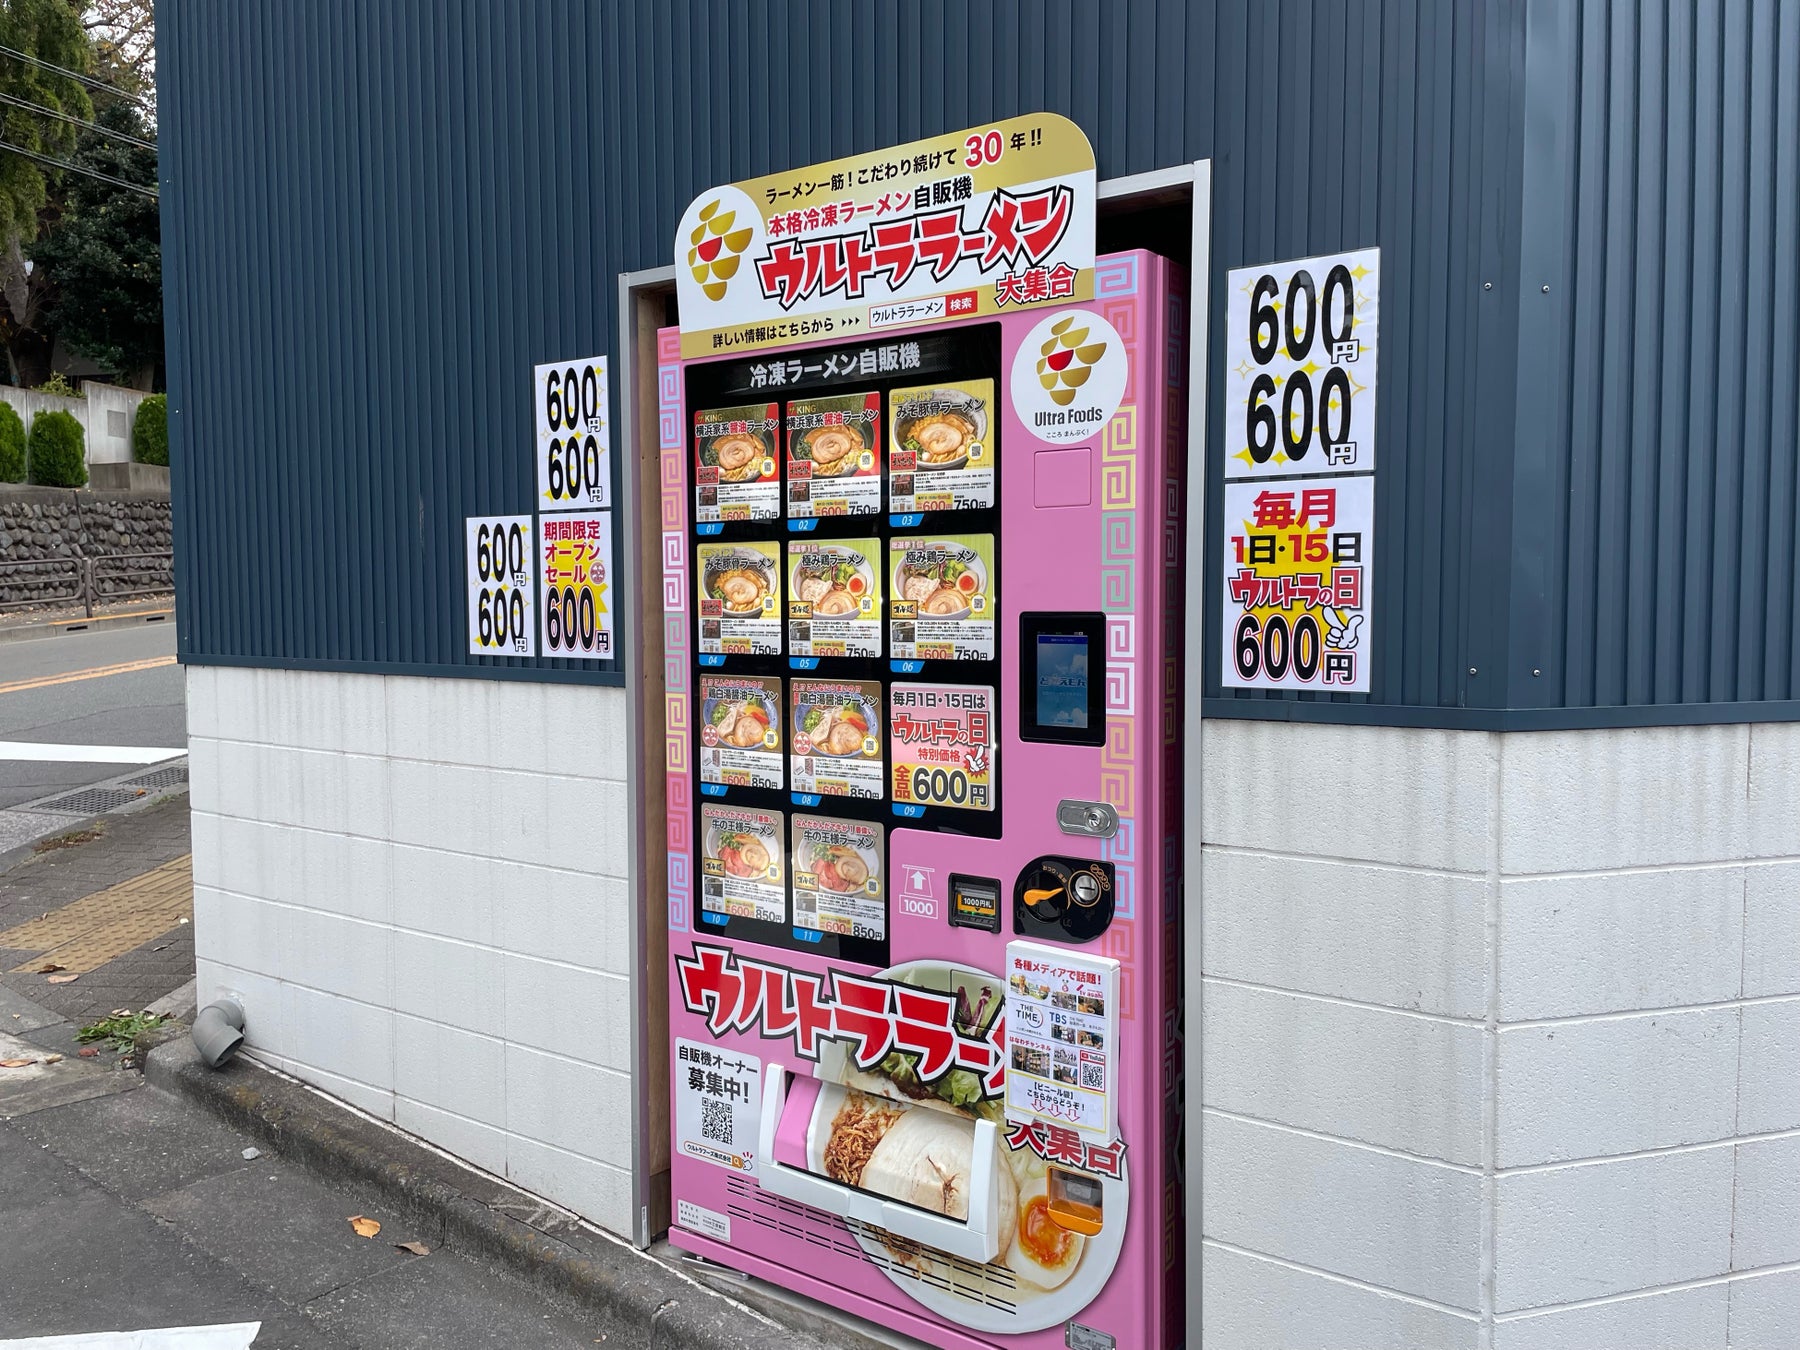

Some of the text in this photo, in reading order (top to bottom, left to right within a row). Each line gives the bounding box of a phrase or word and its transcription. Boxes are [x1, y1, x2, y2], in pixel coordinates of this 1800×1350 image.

[765, 128, 1042, 204] ラーメン一筋!こだわり続けて 30 年!!
[768, 176, 973, 237] 本格冷凍ラーメン自販機
[753, 187, 1074, 310] ウルトララーメン
[995, 264, 1078, 307] 大集合
[872, 300, 944, 324] ウルトララーメン
[949, 297, 973, 312] 検索
[1249, 264, 1360, 364] 600円
[712, 318, 834, 349] 詳しい情報はこちらから
[750, 343, 920, 388] 冷凍ラーメン自販機
[547, 365, 601, 433] 600円
[896, 399, 985, 418] みそ豚骨ラーメン
[704, 414, 723, 423] KING
[796, 405, 816, 414] KING
[1034, 407, 1103, 427] Ultra Foods
[1246, 366, 1357, 466] 600円
[1046, 431, 1063, 439] こころ
[548, 434, 603, 502] 600円
[1253, 488, 1336, 530] 毎月
[706, 524, 715, 533] 01
[798, 520, 808, 530] 02
[901, 515, 913, 525] 03
[544, 520, 601, 541] 期間限定
[477, 522, 526, 587] 600円
[545, 543, 601, 563] オープン
[1231, 532, 1362, 565] 1日・15日
[545, 565, 586, 584] セール
[1227, 566, 1363, 611] ウルトラの日
[478, 587, 528, 652] 600円
[545, 584, 610, 652] 600円
[1233, 613, 1356, 685] 600円
[708, 656, 718, 664] 04
[800, 659, 810, 668] 05
[902, 662, 913, 671] 06
[893, 691, 985, 709] 毎月1日・15日は
[891, 711, 989, 746] ウルトラの日
[918, 748, 960, 762] 特別価格
[710, 786, 719, 794] 07
[894, 765, 911, 799] 全品
[913, 766, 989, 806] 600円
[802, 796, 812, 804] 08
[904, 806, 915, 816] 09
[711, 819, 776, 836] 牛の王様ラーメン
[804, 830, 874, 848] 牛の王様ラーメン
[904, 900, 933, 915] 1000
[712, 915, 720, 923] 10
[803, 931, 812, 940] 11
[1014, 958, 1102, 985] 各種メディアで話題!
[1016, 1010, 1040, 1024] TIME,
[1020, 1004, 1033, 1013] THE
[1049, 1012, 1067, 1025] TBS
[1009, 1036, 1051, 1051] はなわチャンネル
[679, 1045, 758, 1074] 自販機オーナー
[688, 1066, 749, 1104] 募集中!
[1027, 1089, 1084, 1111] こちらからどうぞ!
